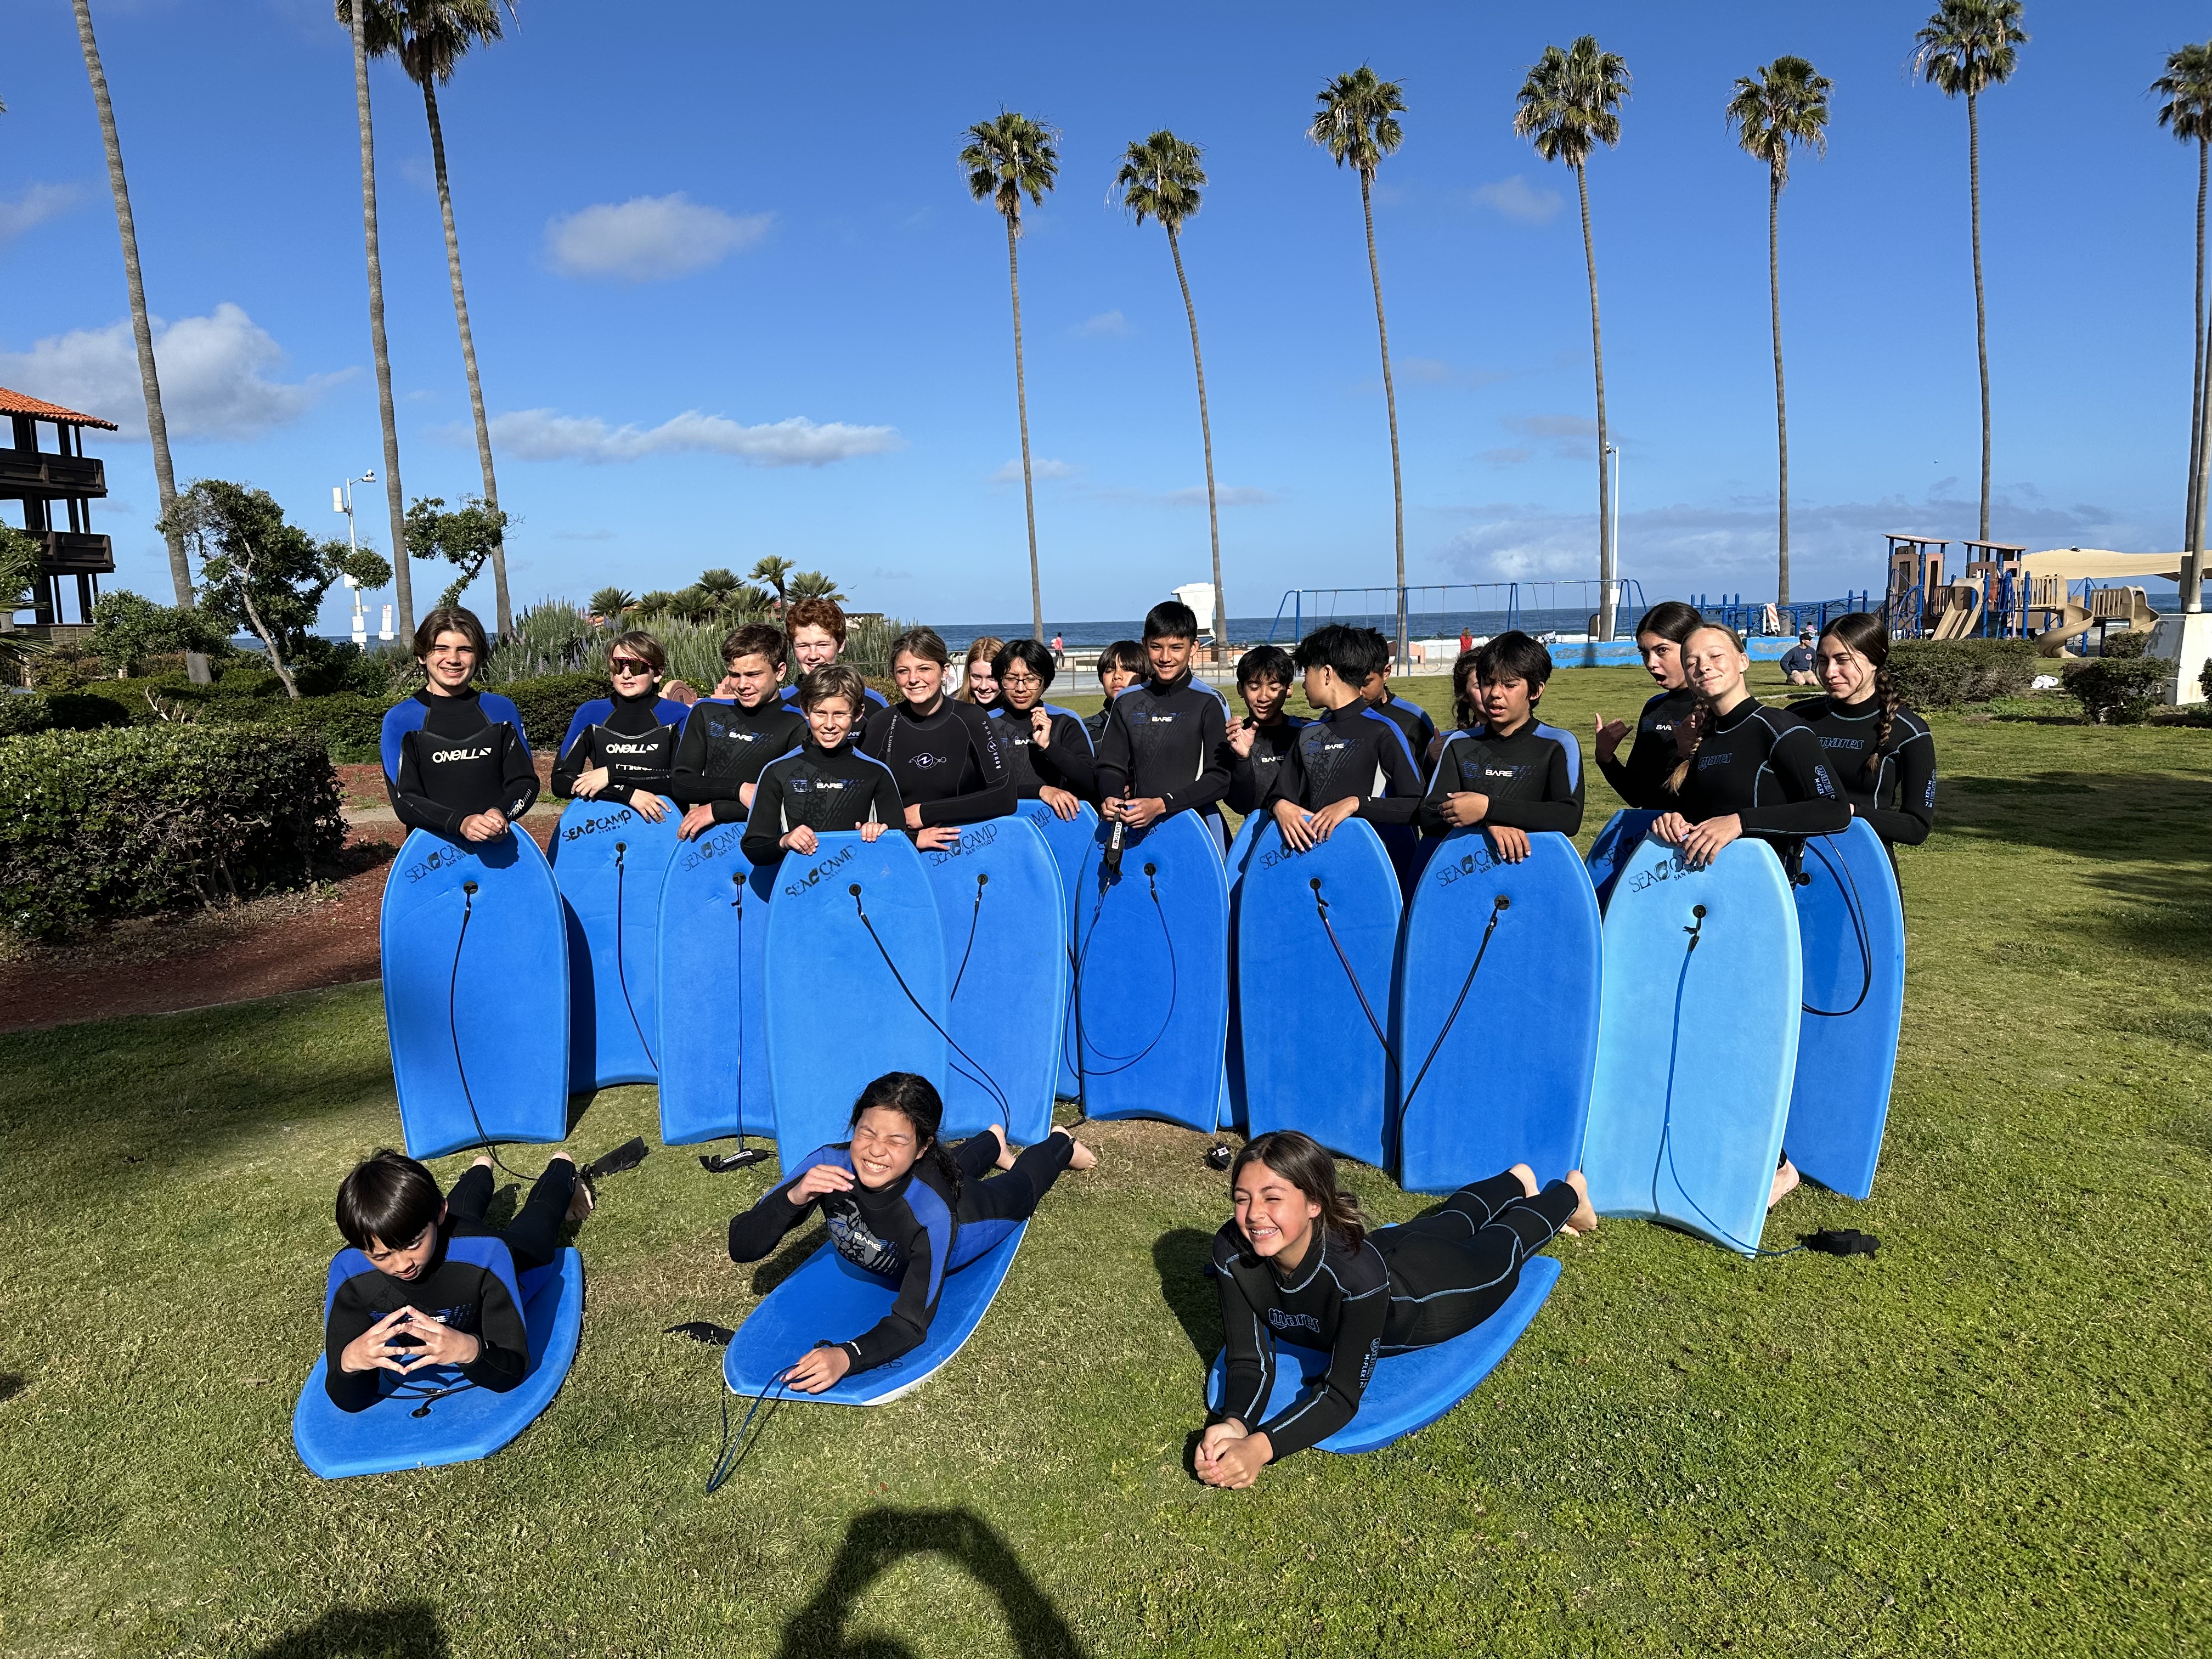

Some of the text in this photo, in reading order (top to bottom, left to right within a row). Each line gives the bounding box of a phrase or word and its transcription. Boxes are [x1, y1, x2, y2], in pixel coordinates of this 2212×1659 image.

[729, 731, 753, 742] BARE
[562, 827, 586, 842] SEA
[595, 809, 631, 830] CAMP
[1030, 806, 1052, 826] MP
[1037, 821, 1047, 830] EGO
[929, 823, 997, 867] SEA CAMP
[966, 839, 991, 856] SAN DIEGO
[445, 858, 457, 867] SAN
[680, 851, 707, 872] SEA
[1259, 850, 1284, 871] SEA
[1479, 864, 1492, 874] SAN
[404, 862, 433, 884] SEA
[785, 879, 812, 901] SEA
[819, 845, 857, 876] CAMP
[1436, 865, 1465, 888] SEA
[1628, 870, 1659, 893] SEA
[1673, 871, 1686, 881] SAN
[854, 1231, 883, 1251] BARE
[1268, 1308, 1320, 1333] mares
[1360, 1354, 1370, 1378] M-FLEX
